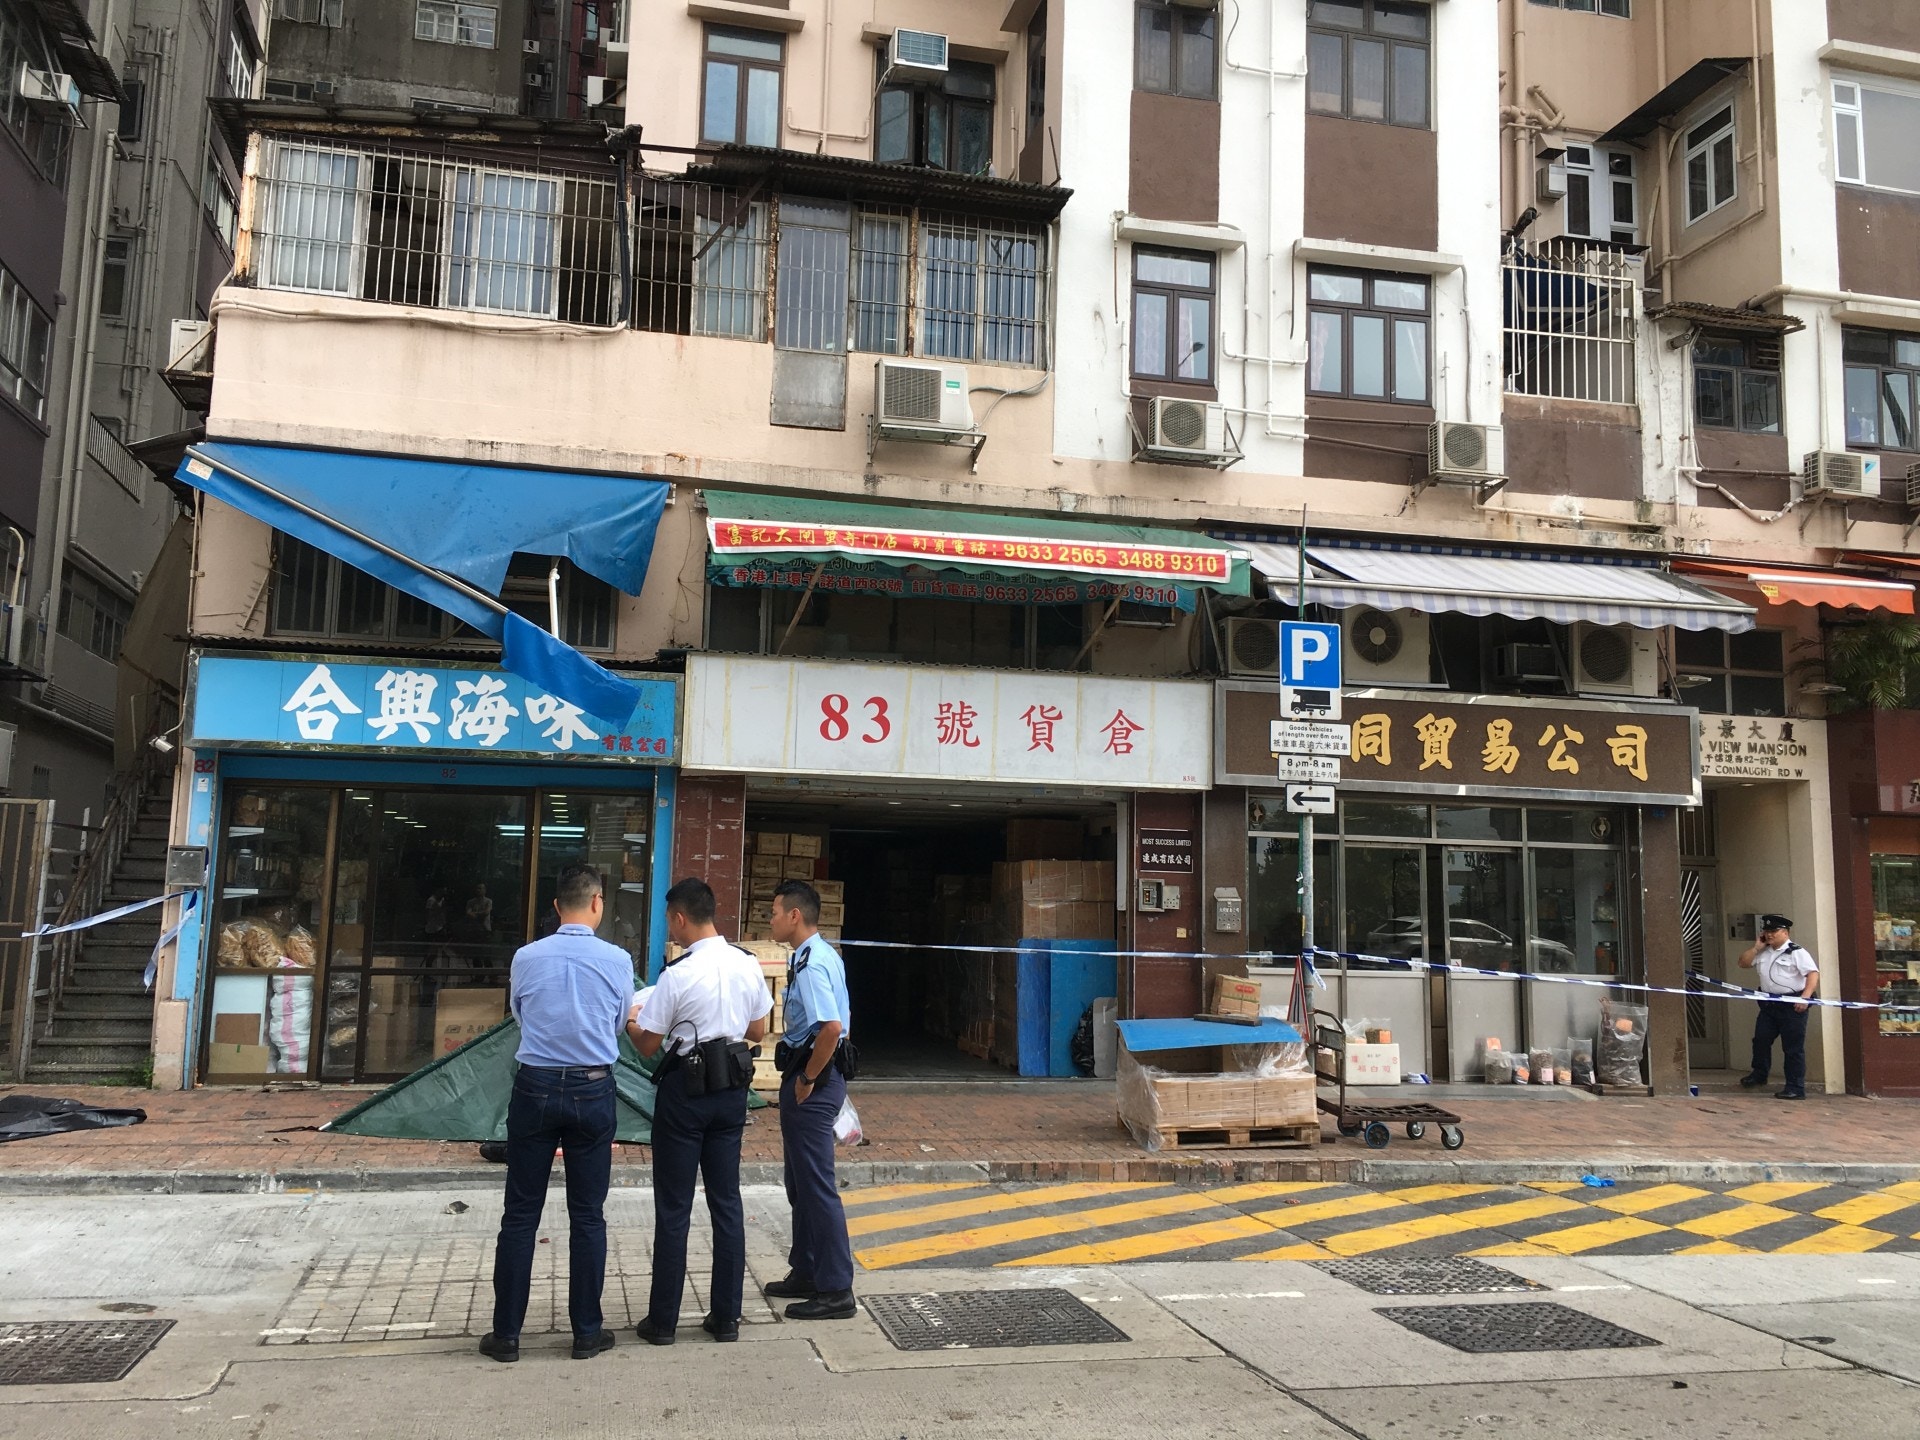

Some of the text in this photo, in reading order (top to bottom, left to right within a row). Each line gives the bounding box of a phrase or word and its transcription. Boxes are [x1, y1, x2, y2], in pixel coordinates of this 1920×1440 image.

[1003, 544, 1053, 561] 9633
[1058, 546, 1107, 565] 2565
[1118, 550, 1165, 570] 3488
[1170, 554, 1218, 573] 9310
[984, 584, 1028, 602] 9633
[1032, 585, 1077, 603] 2565
[1133, 585, 1178, 604] 9310
[1291, 629, 1329, 681] P
[281, 663, 600, 750] 合興海味
[602, 734, 667, 754] 有限公司
[1708, 740, 1741, 754] VIEW
[1748, 741, 1807, 757] MANSION
[194, 759, 216, 774] 82
[1287, 758, 1293, 767] 8
[441, 768, 457, 779] 82
[1715, 765, 1773, 776] CONNAUGHT
[1778, 768, 1790, 777] RD
[1795, 769, 1804, 778] W
[1155, 838, 1175, 846] SUCCESS
[1175, 839, 1192, 847] LIMITED
